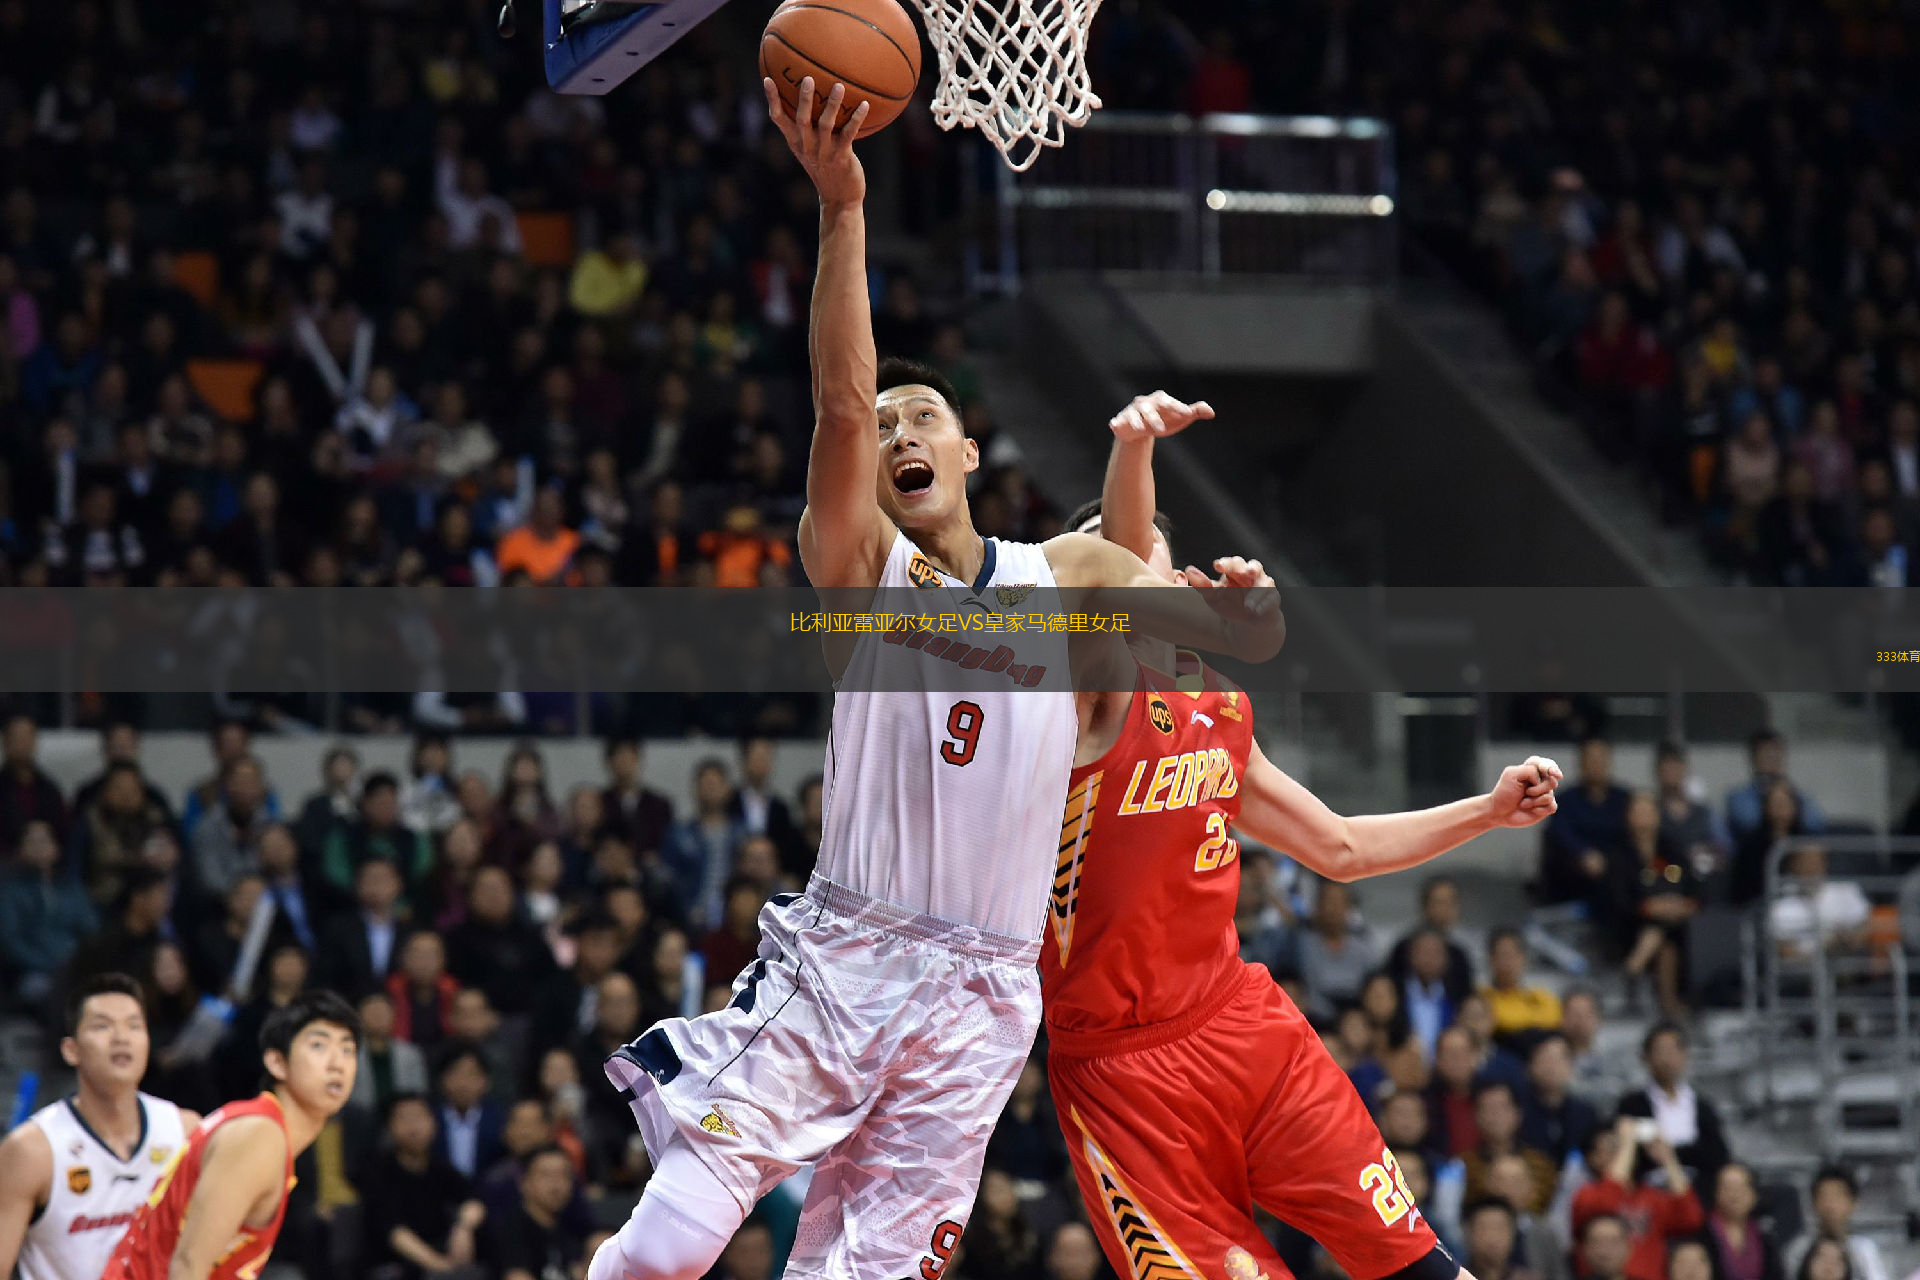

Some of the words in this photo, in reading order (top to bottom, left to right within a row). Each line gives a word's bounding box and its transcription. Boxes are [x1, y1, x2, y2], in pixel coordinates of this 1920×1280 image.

[940, 700, 984, 767] 9
[1151, 704, 1172, 730] ups
[919, 1220, 963, 1280] 9
